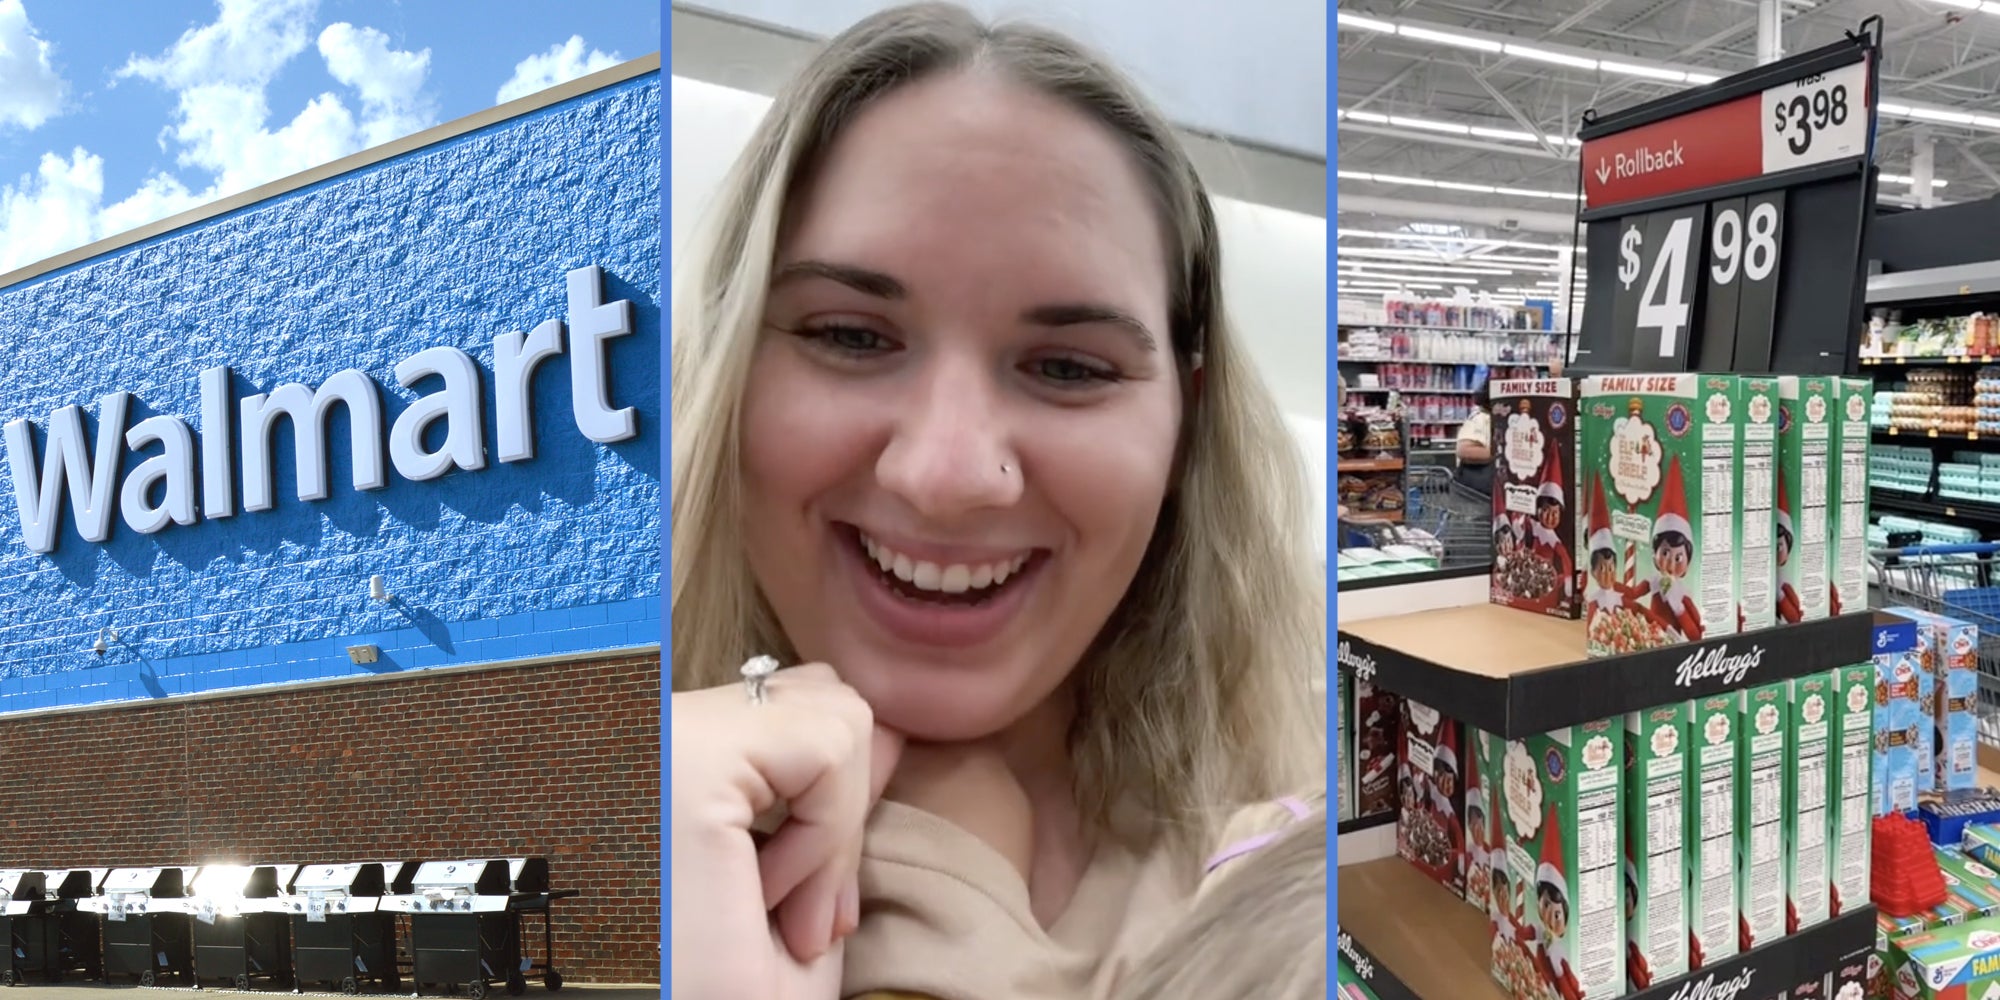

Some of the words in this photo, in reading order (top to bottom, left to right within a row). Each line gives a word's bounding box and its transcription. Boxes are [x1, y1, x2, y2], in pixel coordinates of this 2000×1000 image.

[1615, 140, 1684, 179] Rollback
[1501, 382, 1533, 393] FAMILY
[1535, 381, 1557, 393] SIZE
[1601, 377, 1644, 392] FAMILY
[1646, 377, 1677, 392] SIZE
[4, 264, 638, 554] Walmart
[1675, 643, 1766, 687] Kellogg's
